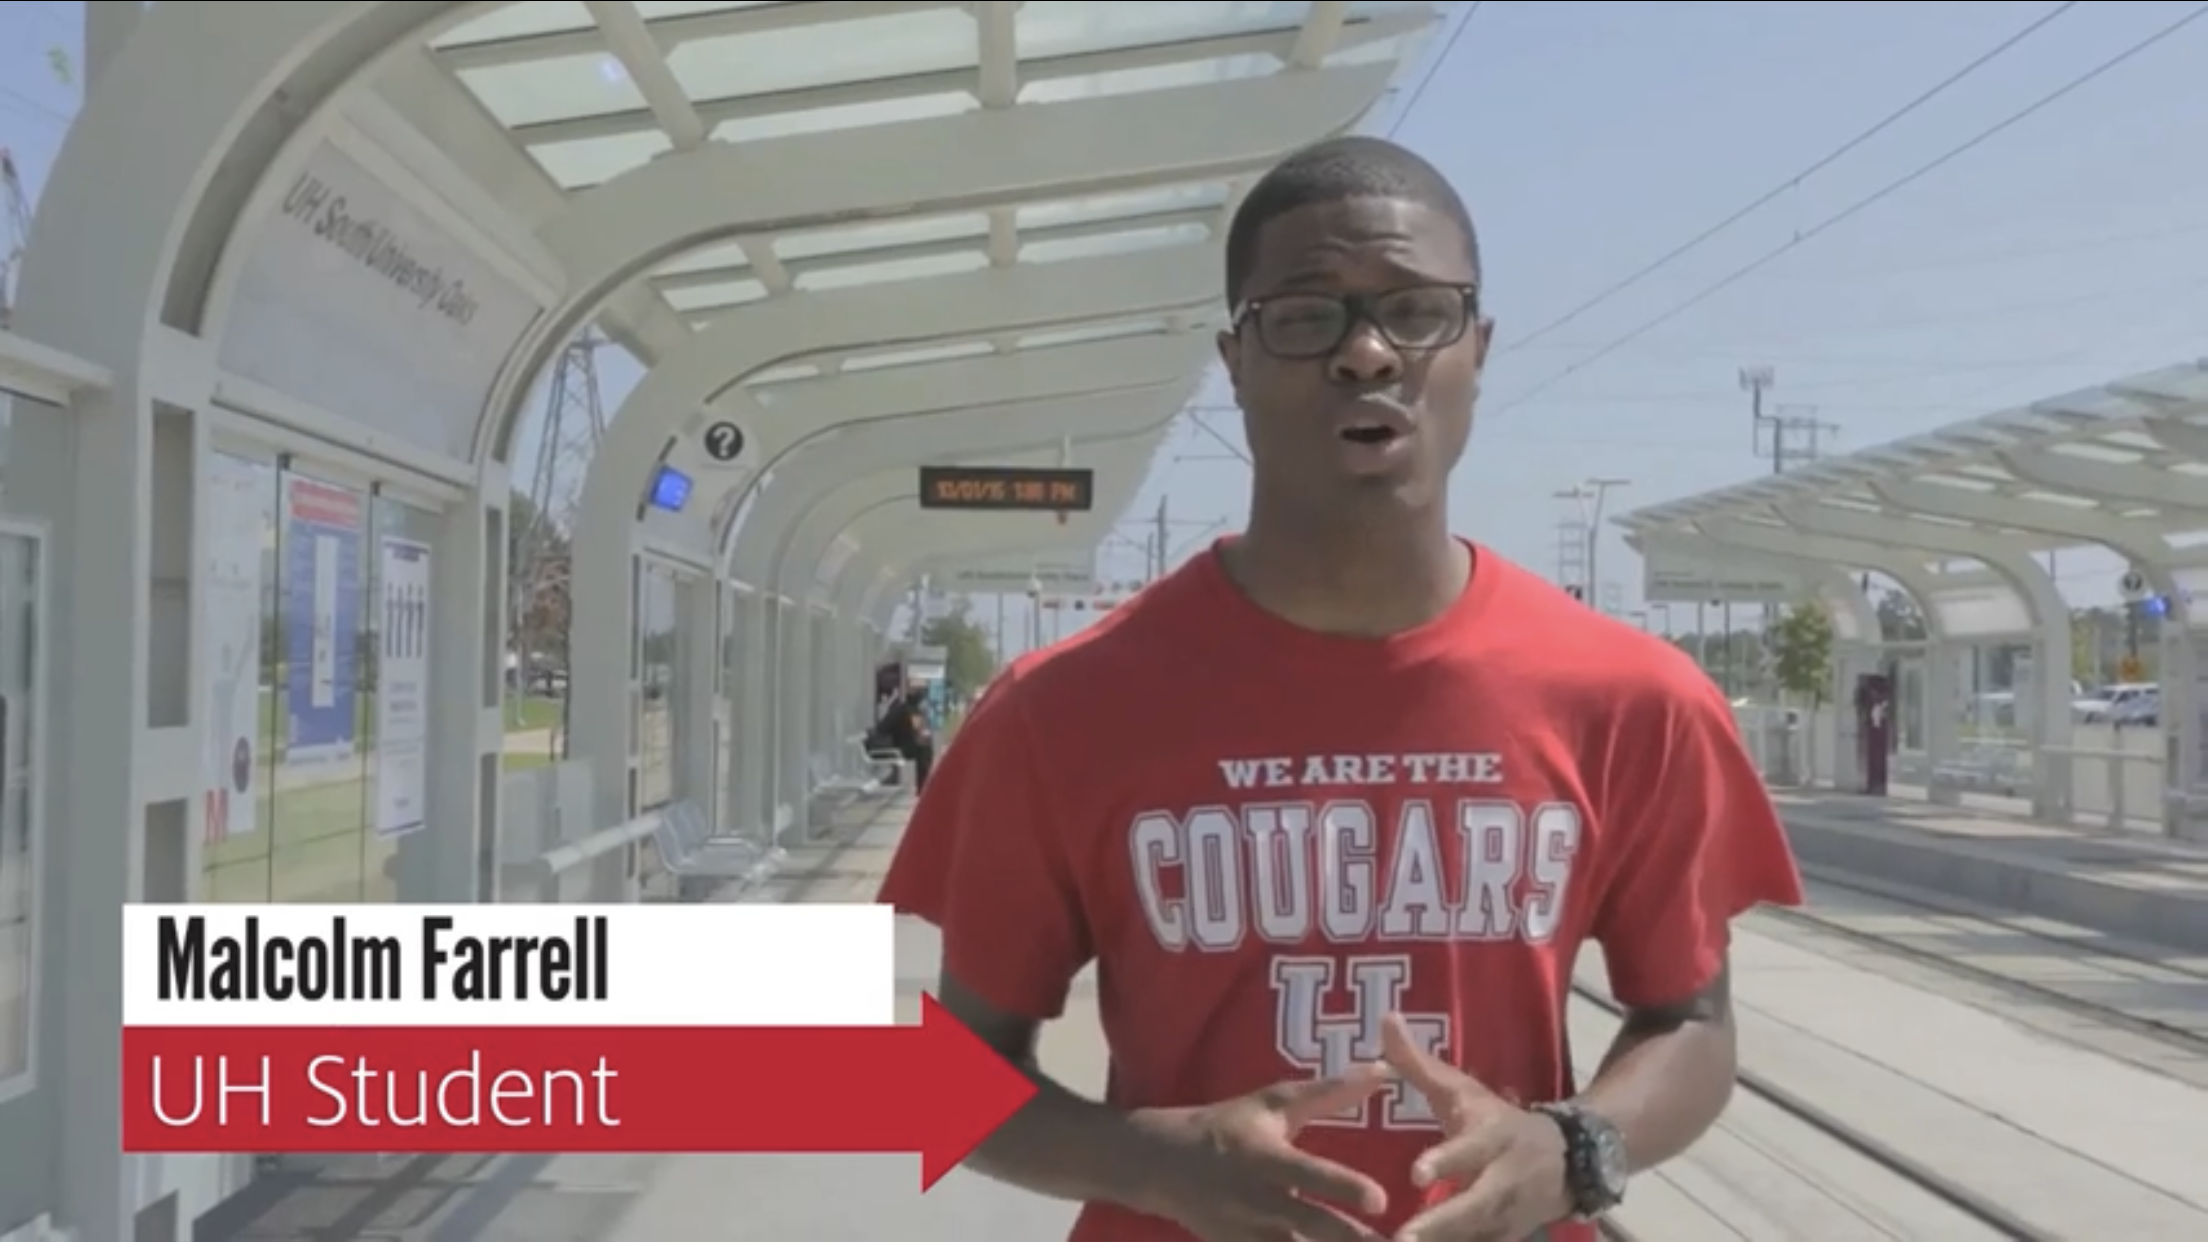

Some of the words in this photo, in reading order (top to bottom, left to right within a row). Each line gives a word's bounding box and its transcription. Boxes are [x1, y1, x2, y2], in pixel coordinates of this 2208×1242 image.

[282, 172, 331, 224] UH
[314, 196, 379, 260] South
[365, 228, 444, 309] University
[1050, 482, 1076, 502] PM
[1218, 757, 1293, 788] WE
[1301, 754, 1395, 784] ARE
[1403, 753, 1503, 783] THE
[1128, 799, 1581, 953] COUGARS
